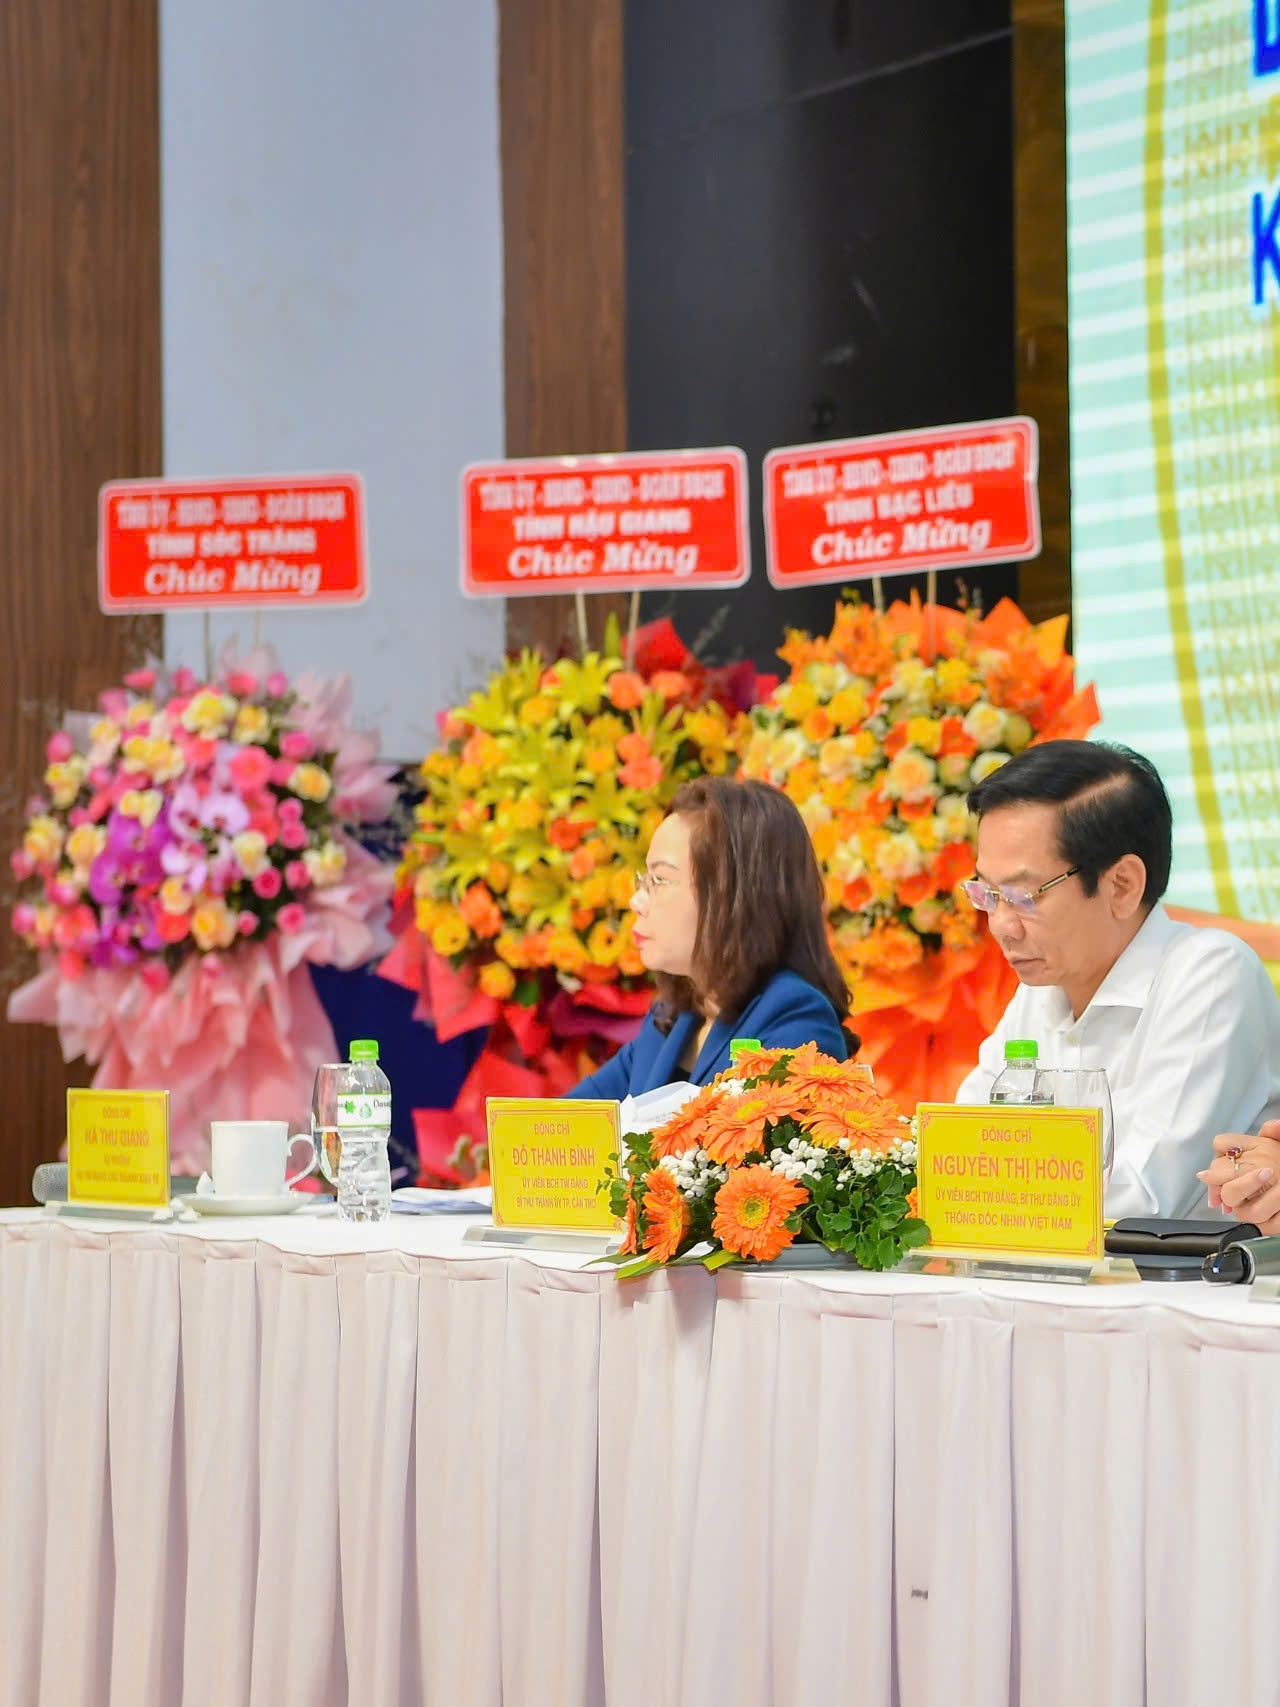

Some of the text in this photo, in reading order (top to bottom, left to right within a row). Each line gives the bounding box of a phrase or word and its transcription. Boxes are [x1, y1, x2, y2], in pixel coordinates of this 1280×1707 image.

[508, 538, 700, 578] Chúc Mừng
[812, 516, 992, 566] Chúc Mừng
[145, 557, 322, 597] Chúc Mừng
[530, 1148, 567, 1167] THANH
[569, 1144, 595, 1167] BÌNH
[933, 1152, 1084, 1184] NGUYỄN THỊ HỒNG
[1051, 1217, 1072, 1230] NAM
